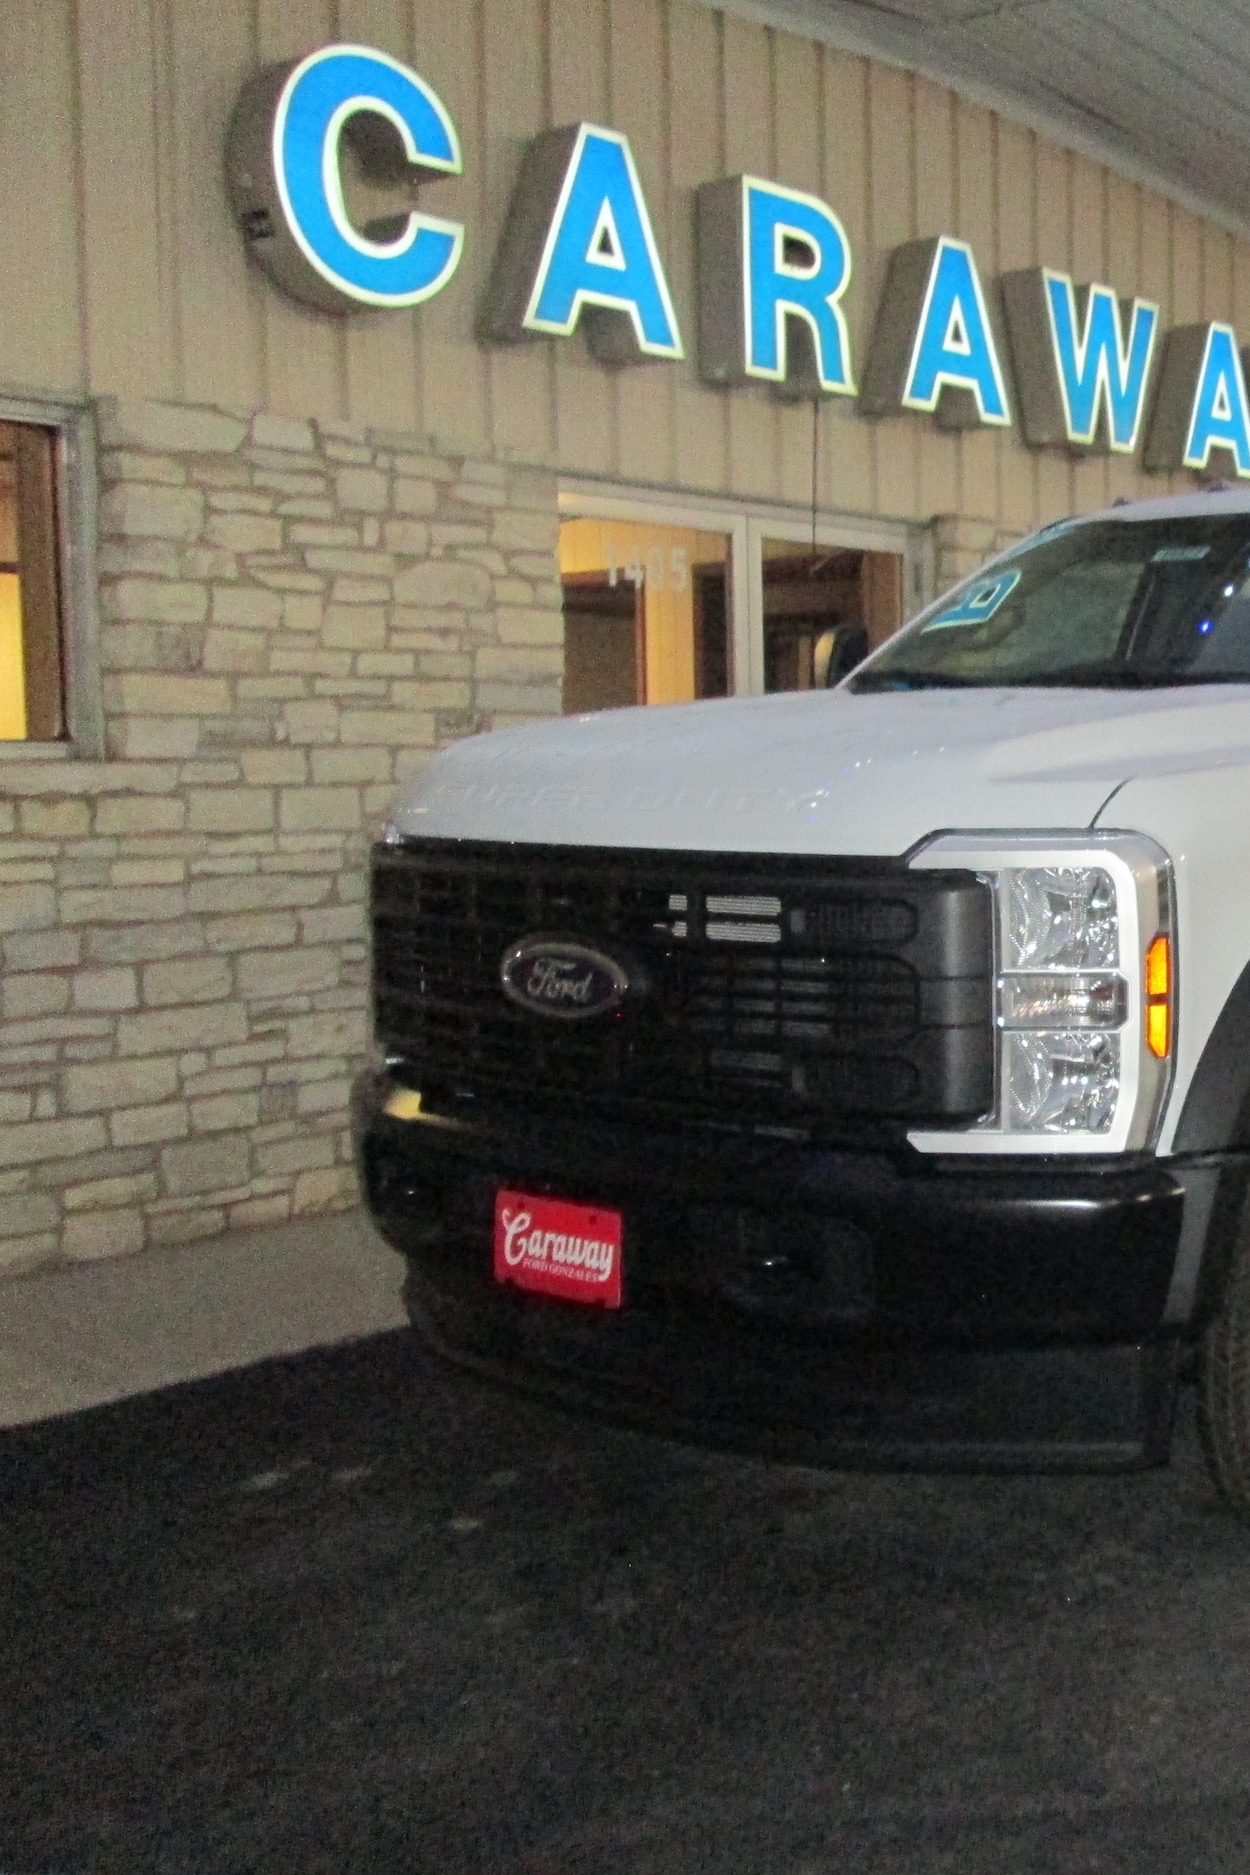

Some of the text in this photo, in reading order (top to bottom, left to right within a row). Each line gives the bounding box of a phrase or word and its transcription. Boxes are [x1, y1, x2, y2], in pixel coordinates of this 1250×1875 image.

[604, 542, 688, 591] 1405
[527, 959, 593, 1003] Ford
[502, 1208, 615, 1282] Caraway
[523, 1258, 600, 1283] FORD GONZALES
